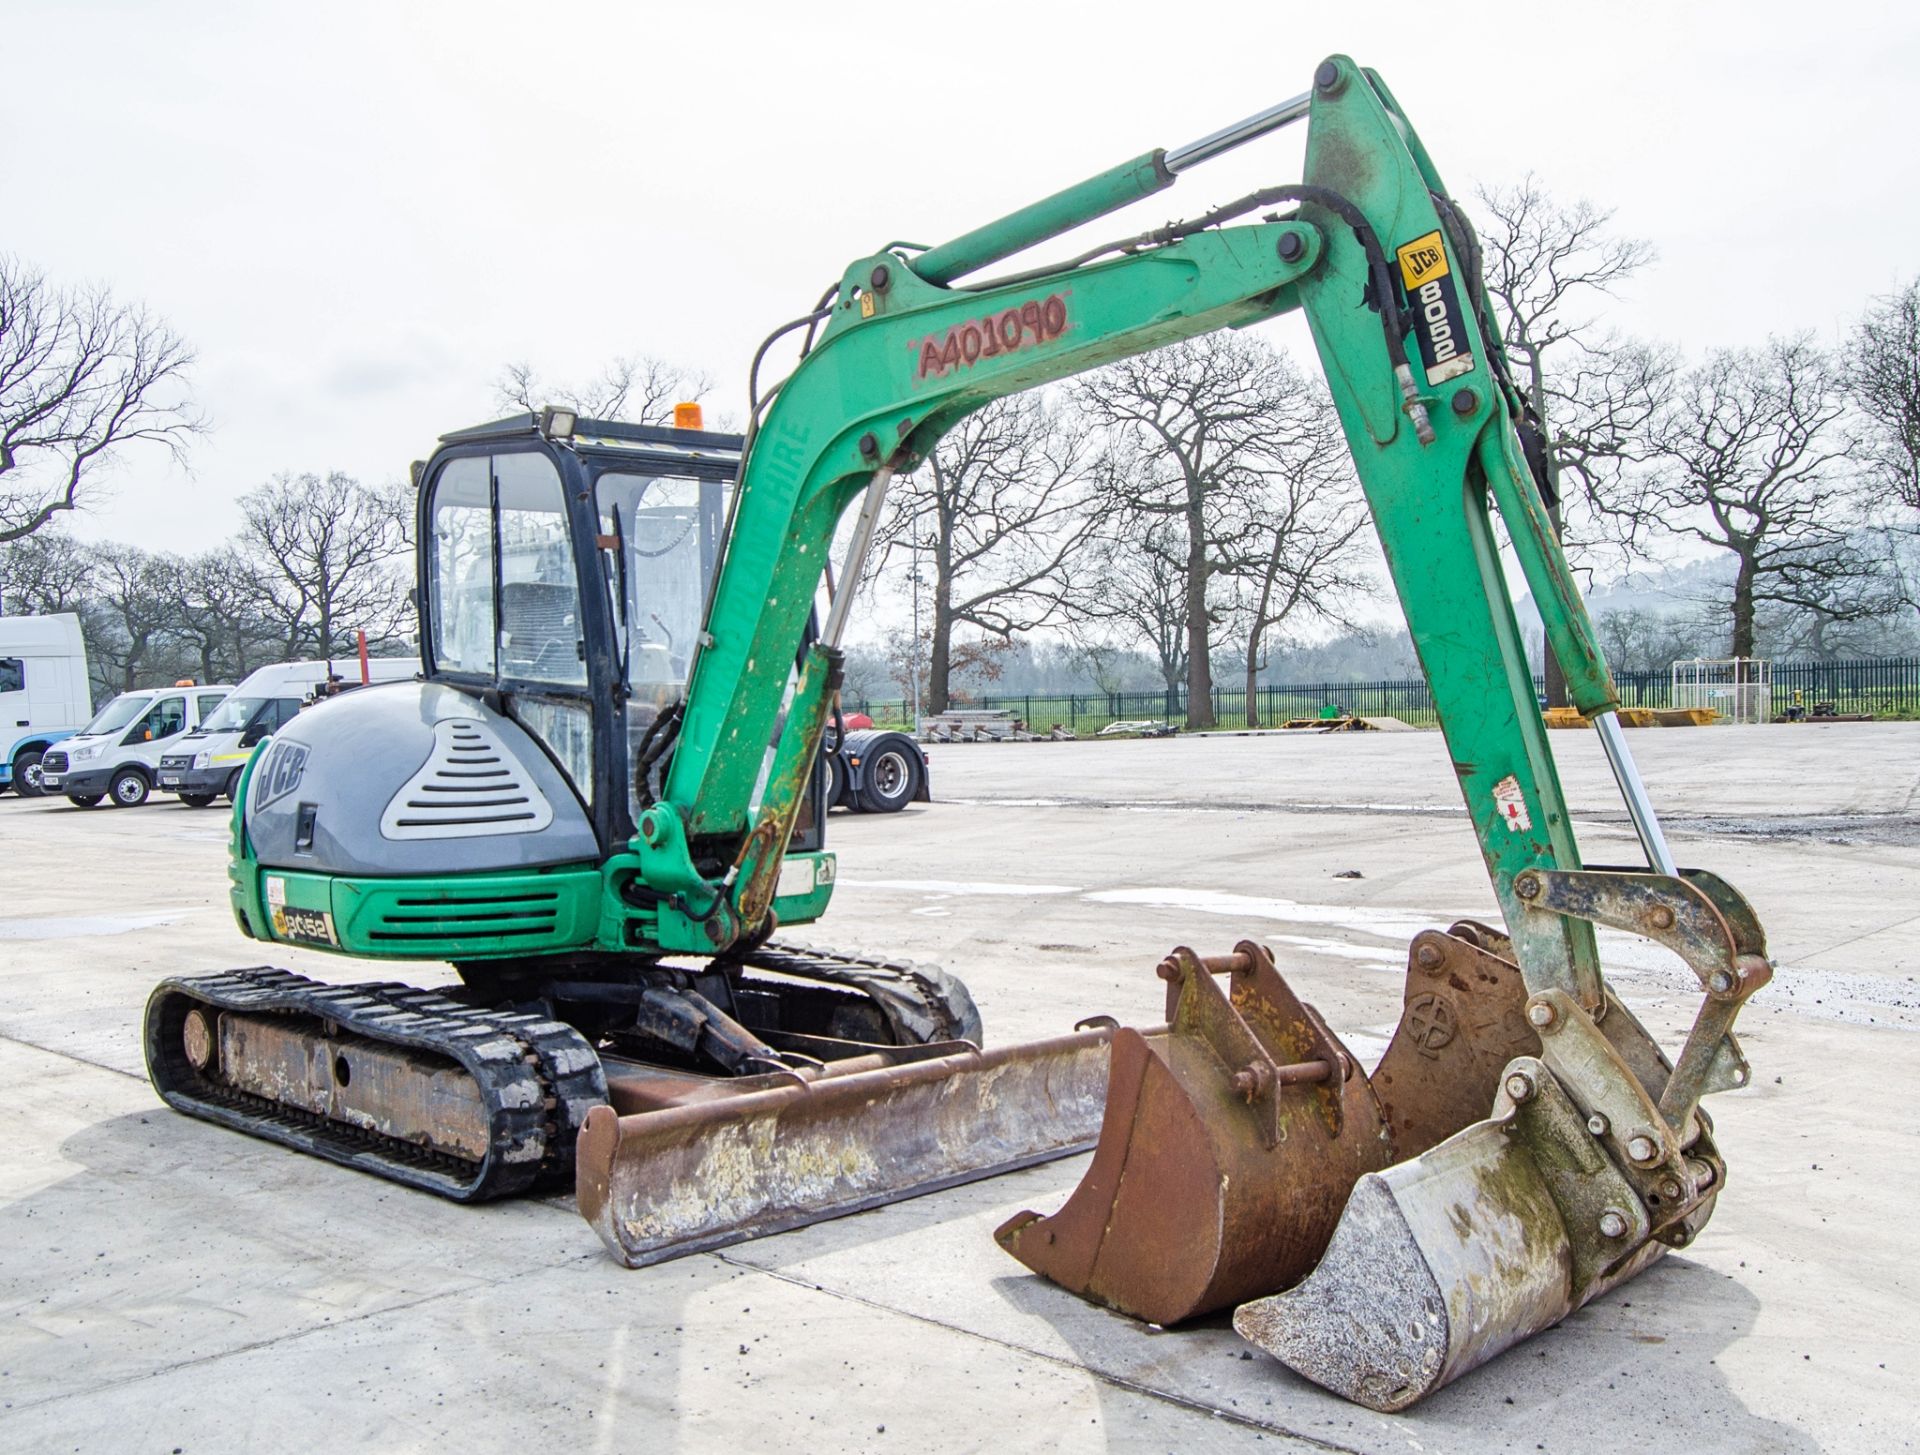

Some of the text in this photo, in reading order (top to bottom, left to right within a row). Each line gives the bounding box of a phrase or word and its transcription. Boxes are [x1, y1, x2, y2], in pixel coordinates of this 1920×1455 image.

[1409, 249, 1439, 275] JCB
[918, 295, 1066, 378] A401090
[1419, 280, 1457, 362] 8052
[763, 422, 812, 504] HIRE
[258, 743, 306, 805] JCB
